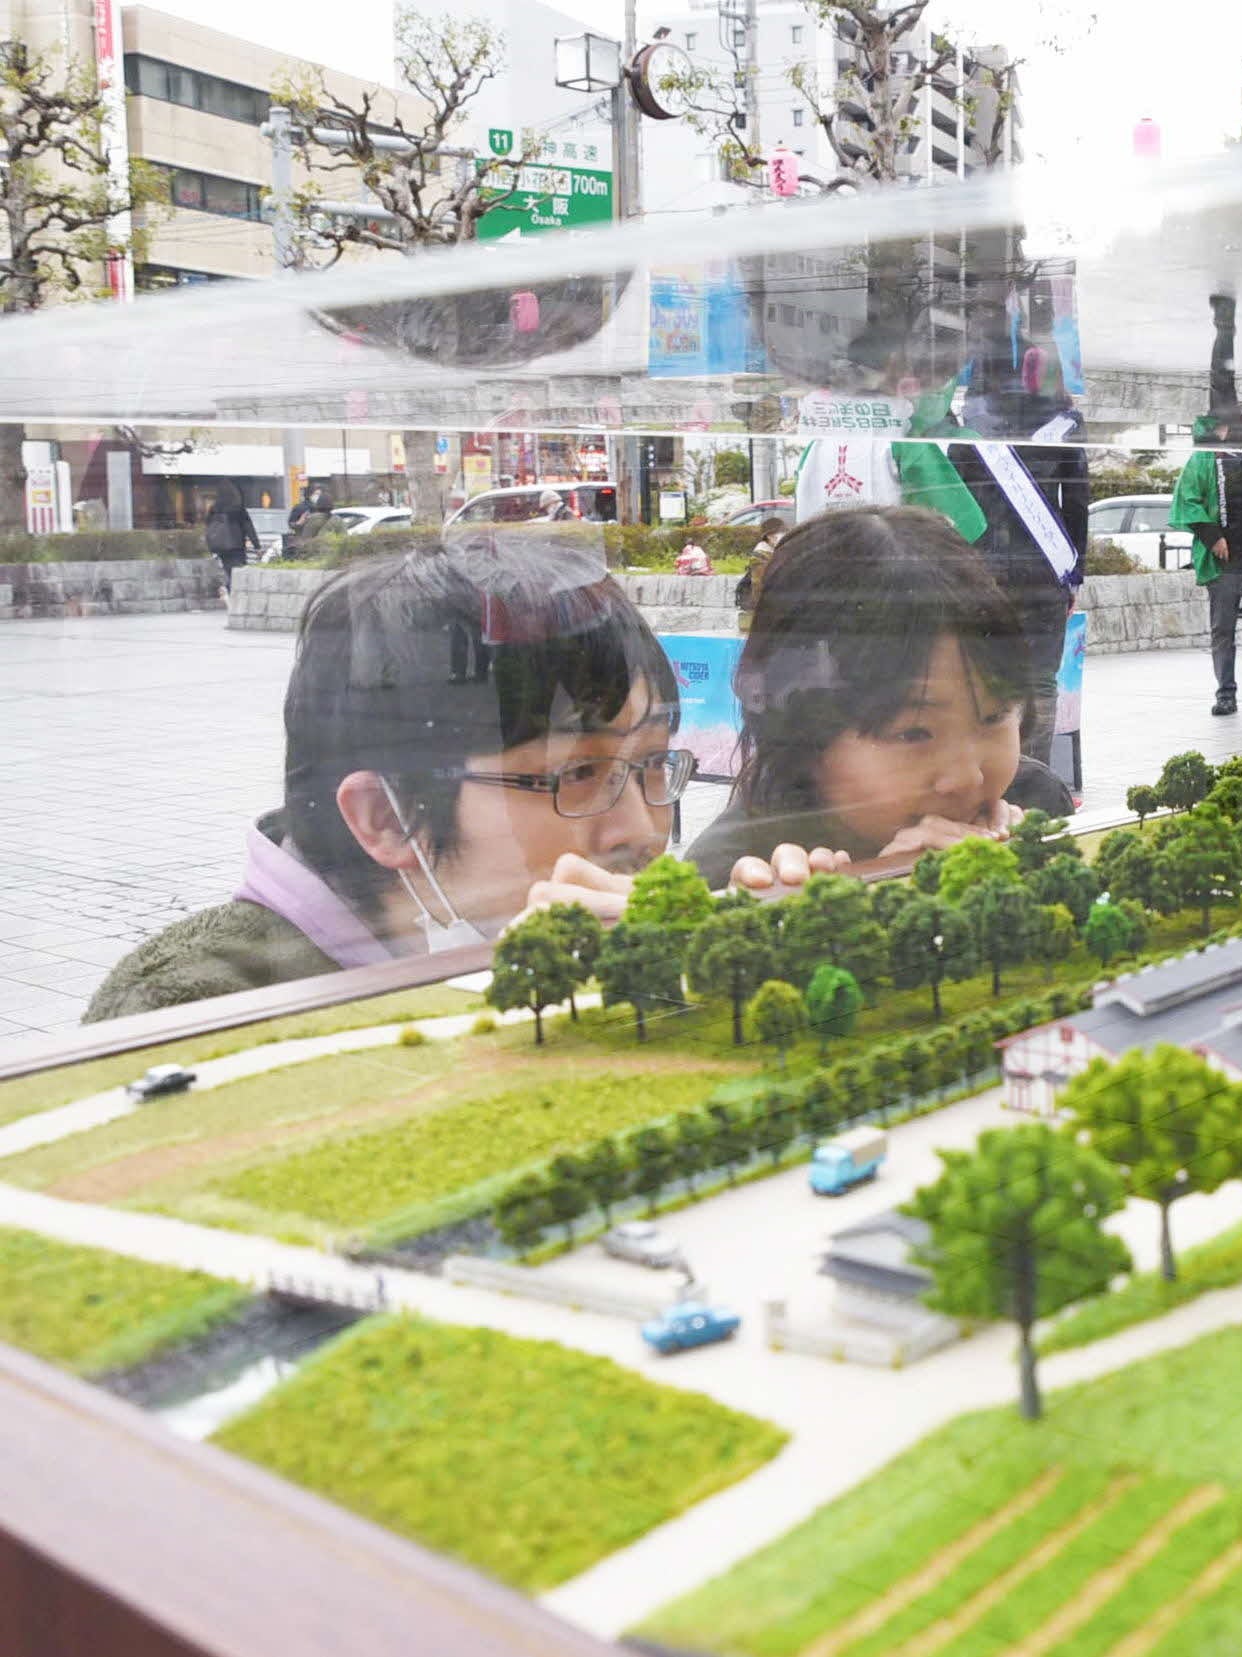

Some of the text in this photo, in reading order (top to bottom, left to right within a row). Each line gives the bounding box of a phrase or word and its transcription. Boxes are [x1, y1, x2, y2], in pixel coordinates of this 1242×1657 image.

[493, 132, 509, 150] 11
[523, 137, 599, 162] 神高速
[573, 174, 608, 196] 700m
[523, 195, 570, 216] 大阪
